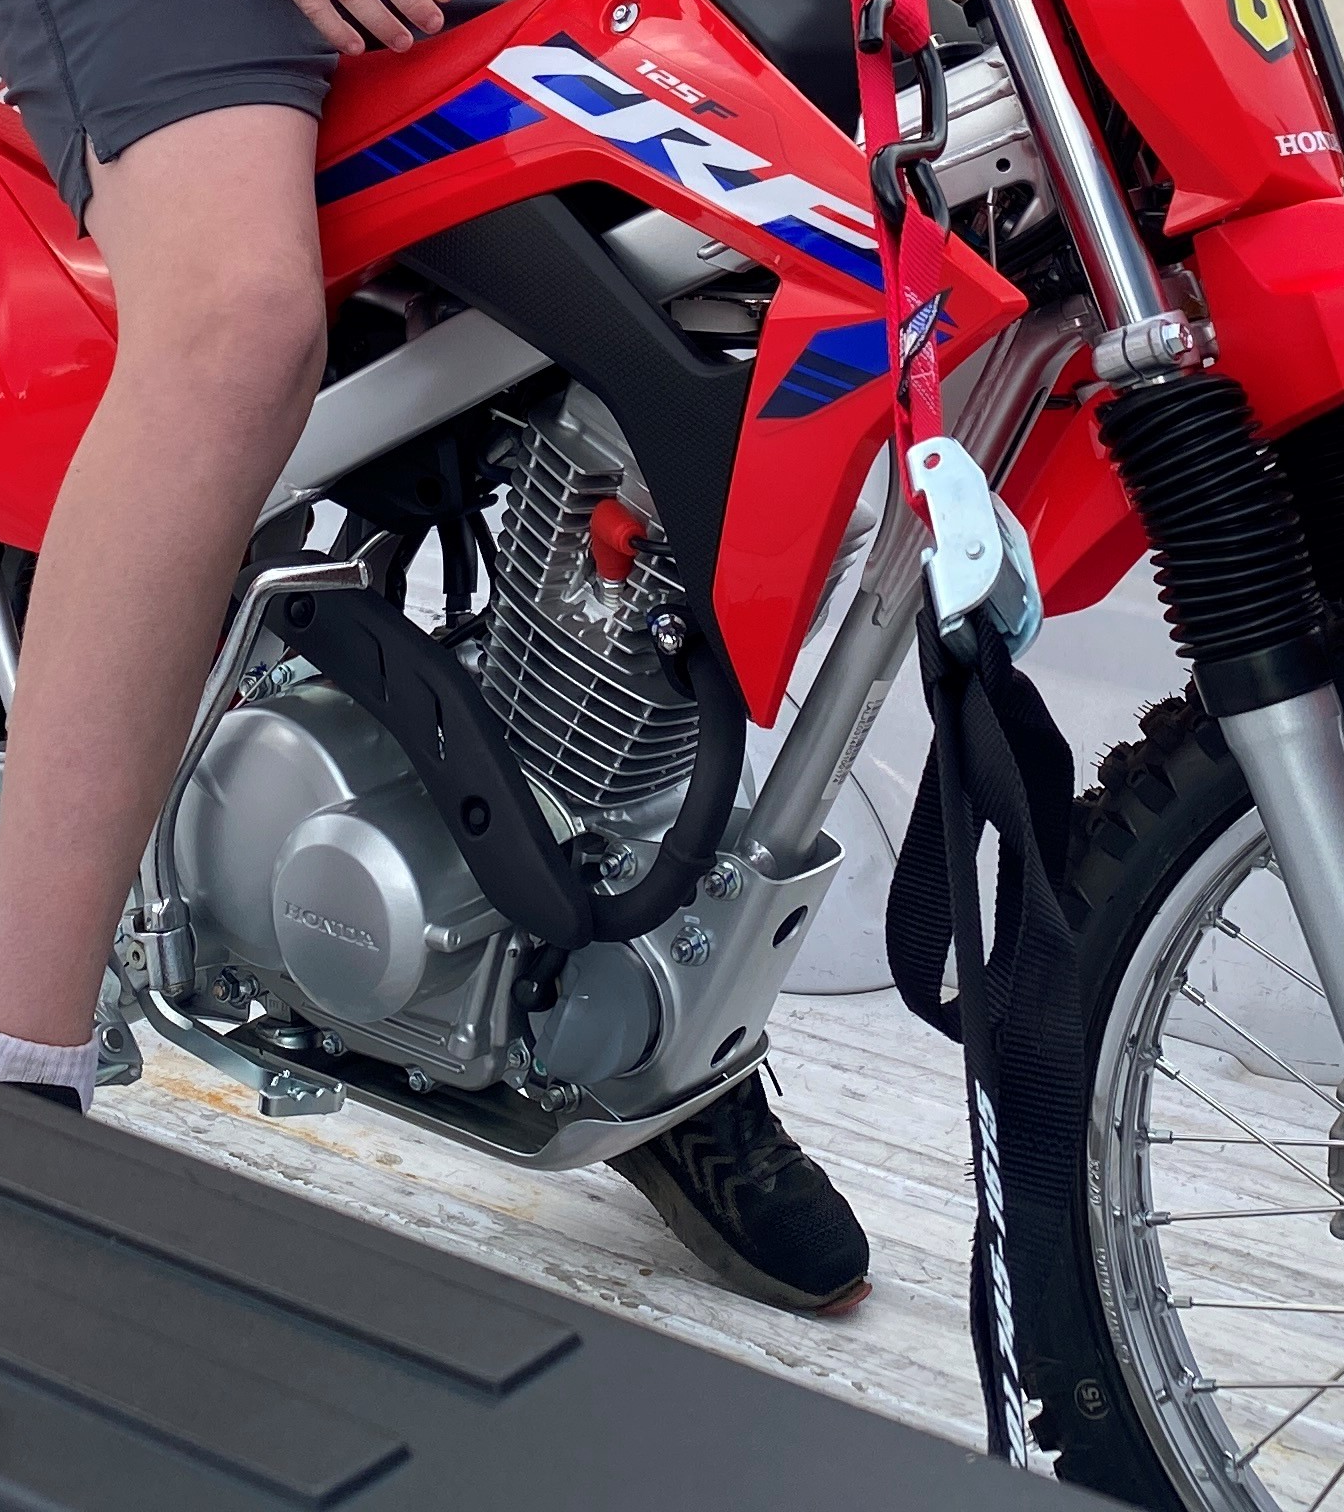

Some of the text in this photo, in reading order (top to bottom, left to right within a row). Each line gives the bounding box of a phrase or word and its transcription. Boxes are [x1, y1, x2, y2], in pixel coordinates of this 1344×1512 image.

[635, 58, 739, 119] 125F
[487, 44, 882, 250] CRF
[280, 897, 380, 952] HONDA
